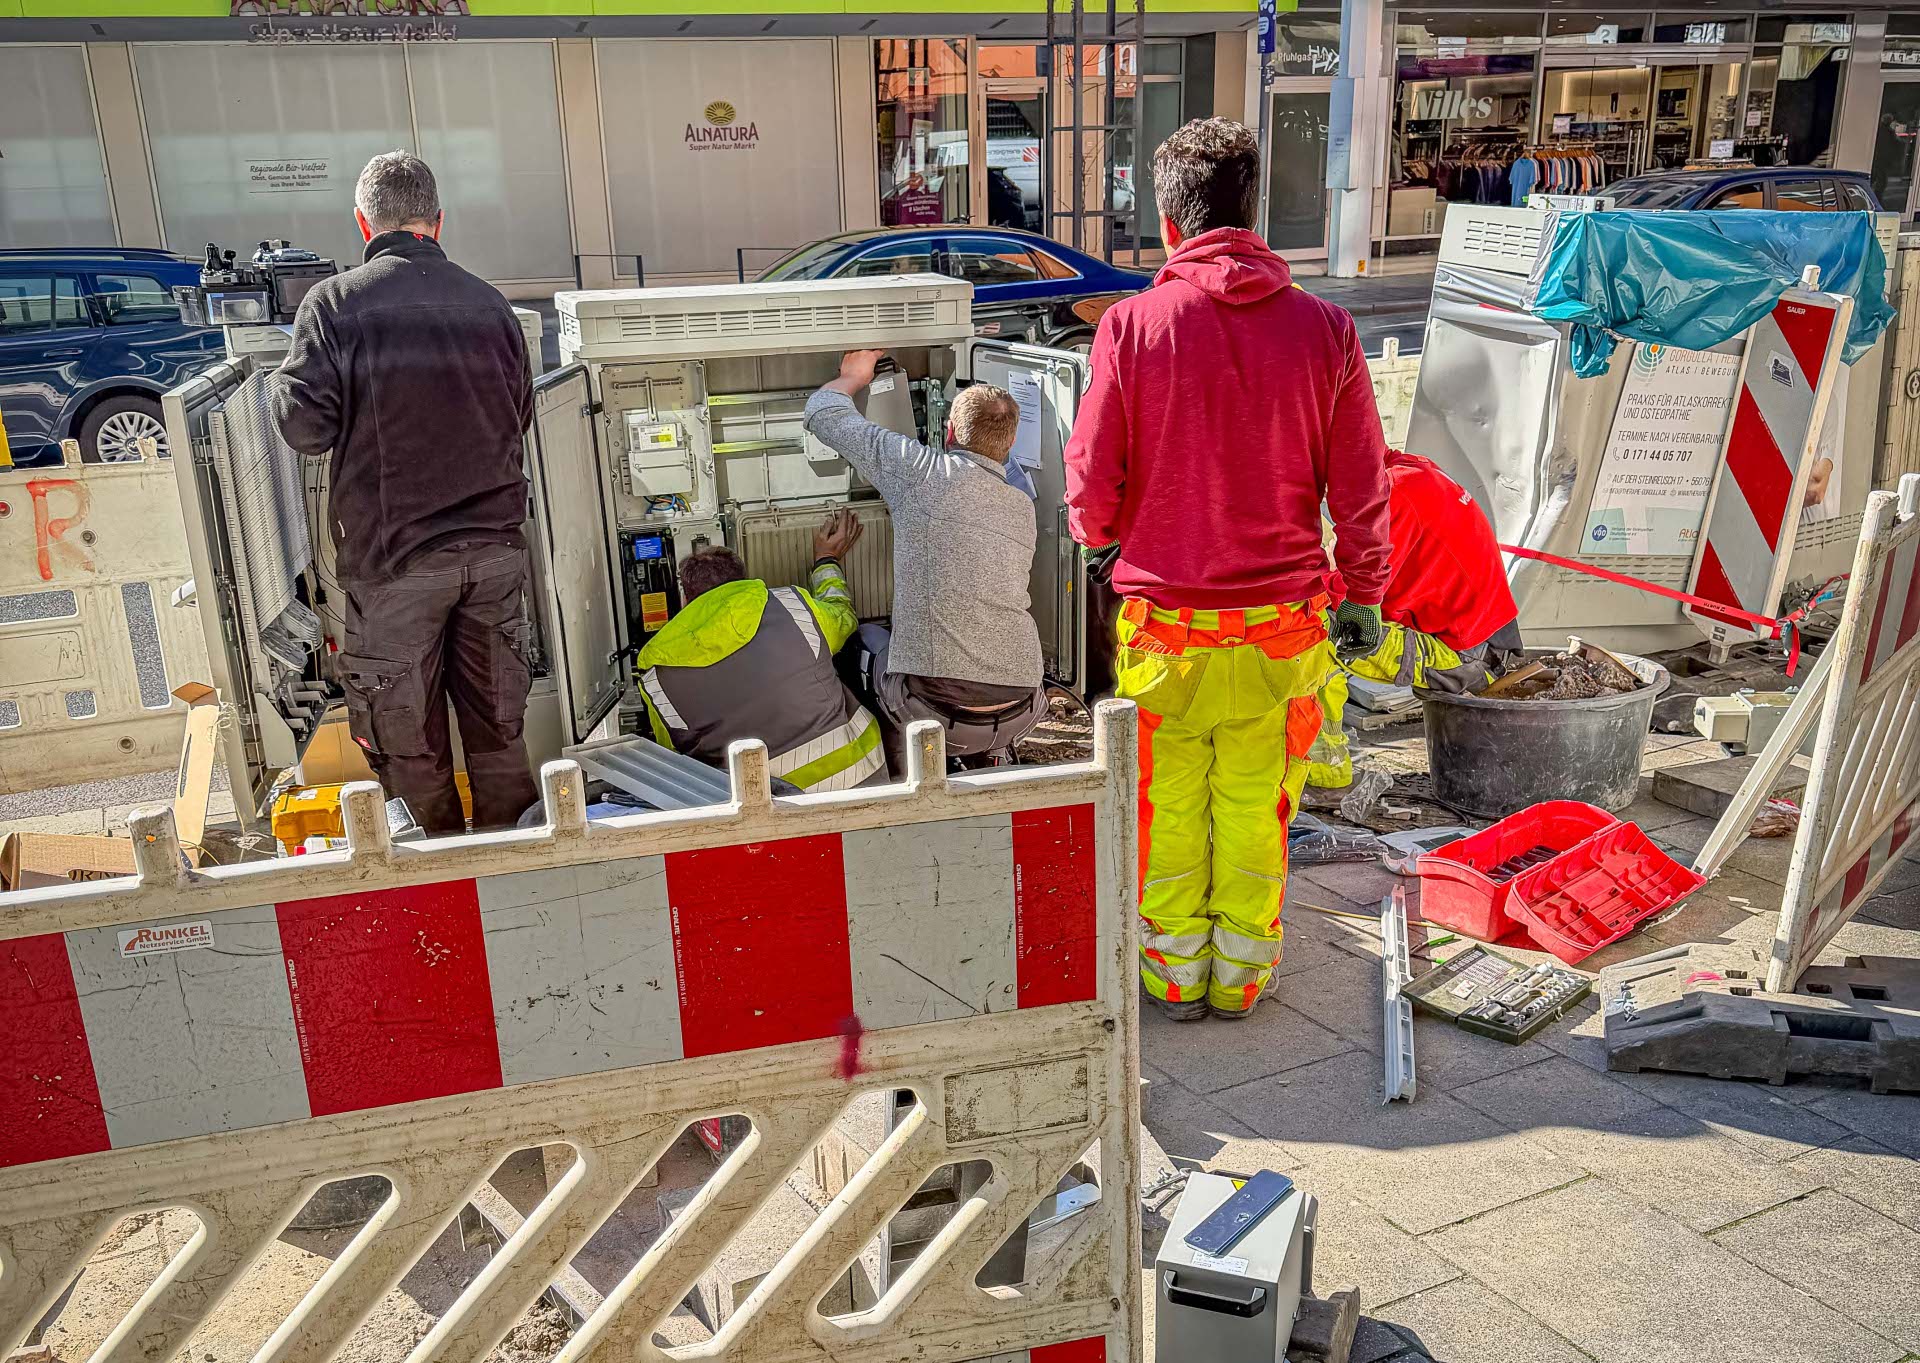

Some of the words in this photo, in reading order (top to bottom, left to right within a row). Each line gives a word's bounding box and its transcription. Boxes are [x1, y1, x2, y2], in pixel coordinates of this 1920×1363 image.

[248, 22, 314, 47] Super
[322, 23, 386, 42] Natur
[392, 22, 459, 42] Markt
[1415, 89, 1494, 120] Nilles
[684, 121, 760, 142] ALNATURA
[689, 143, 710, 152] Super
[711, 142, 732, 150] Natur
[733, 142, 756, 150] Markt
[250, 164, 284, 176] Regionale
[285, 162, 327, 173] Bio-Vielfalt
[1786, 306, 1806, 315] SAUER
[1665, 365, 1691, 374] ATLAS
[1701, 367, 1738, 376] BEWEGUN
[1626, 393, 1656, 406] PRAXIS
[1656, 393, 1673, 407] FÜR
[1623, 407, 1640, 419] UND
[1640, 408, 1692, 420] OSTEOPATHIE
[1617, 430, 1649, 442] TERMINE
[1649, 431, 1670, 443] NACH
[1622, 448, 1630, 460] 0
[1632, 449, 1648, 460] 171
[1649, 450, 1661, 461] 44
[1662, 450, 1675, 461] 05
[1676, 450, 1693, 462] 707
[1612, 474, 1625, 483] AUF
[1625, 474, 1637, 484] DER
[26, 477, 96, 580] R
[1679, 528, 1699, 539] Atla
[137, 925, 209, 943] RUNKEL
[139, 938, 185, 949] Netzservice
[186, 935, 211, 944] GmbH
